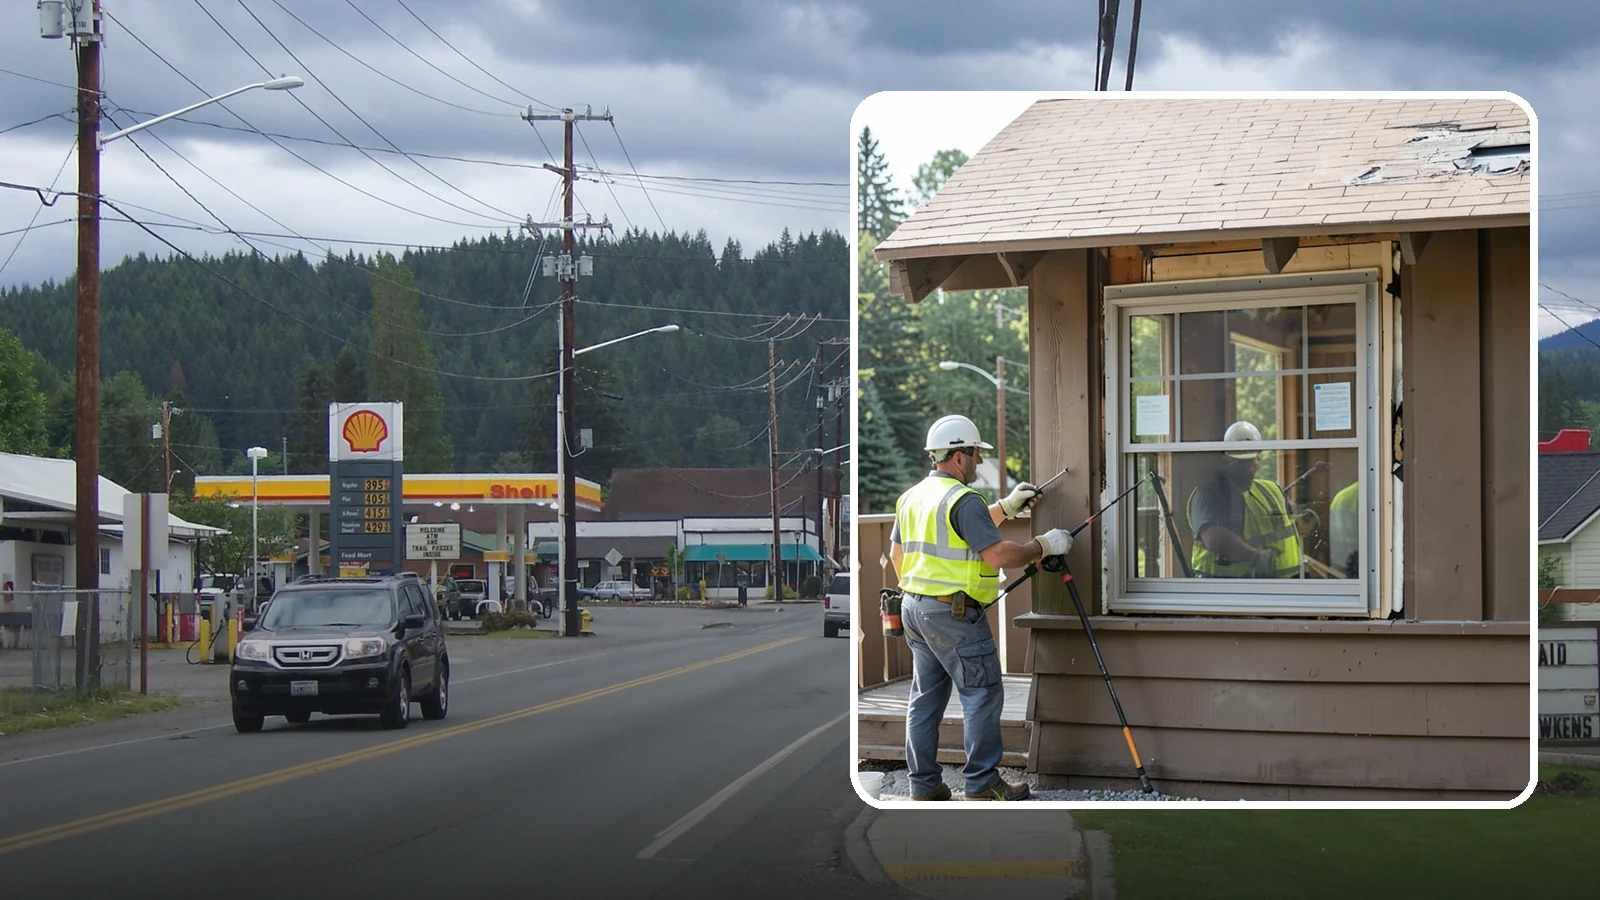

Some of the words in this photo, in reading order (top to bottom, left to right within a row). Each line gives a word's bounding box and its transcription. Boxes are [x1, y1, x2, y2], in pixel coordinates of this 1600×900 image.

[366, 480, 384, 490] 395
[490, 484, 547, 499] Shell
[366, 494, 384, 504] 405
[366, 508, 383, 518] 415
[366, 522, 384, 533] 429
